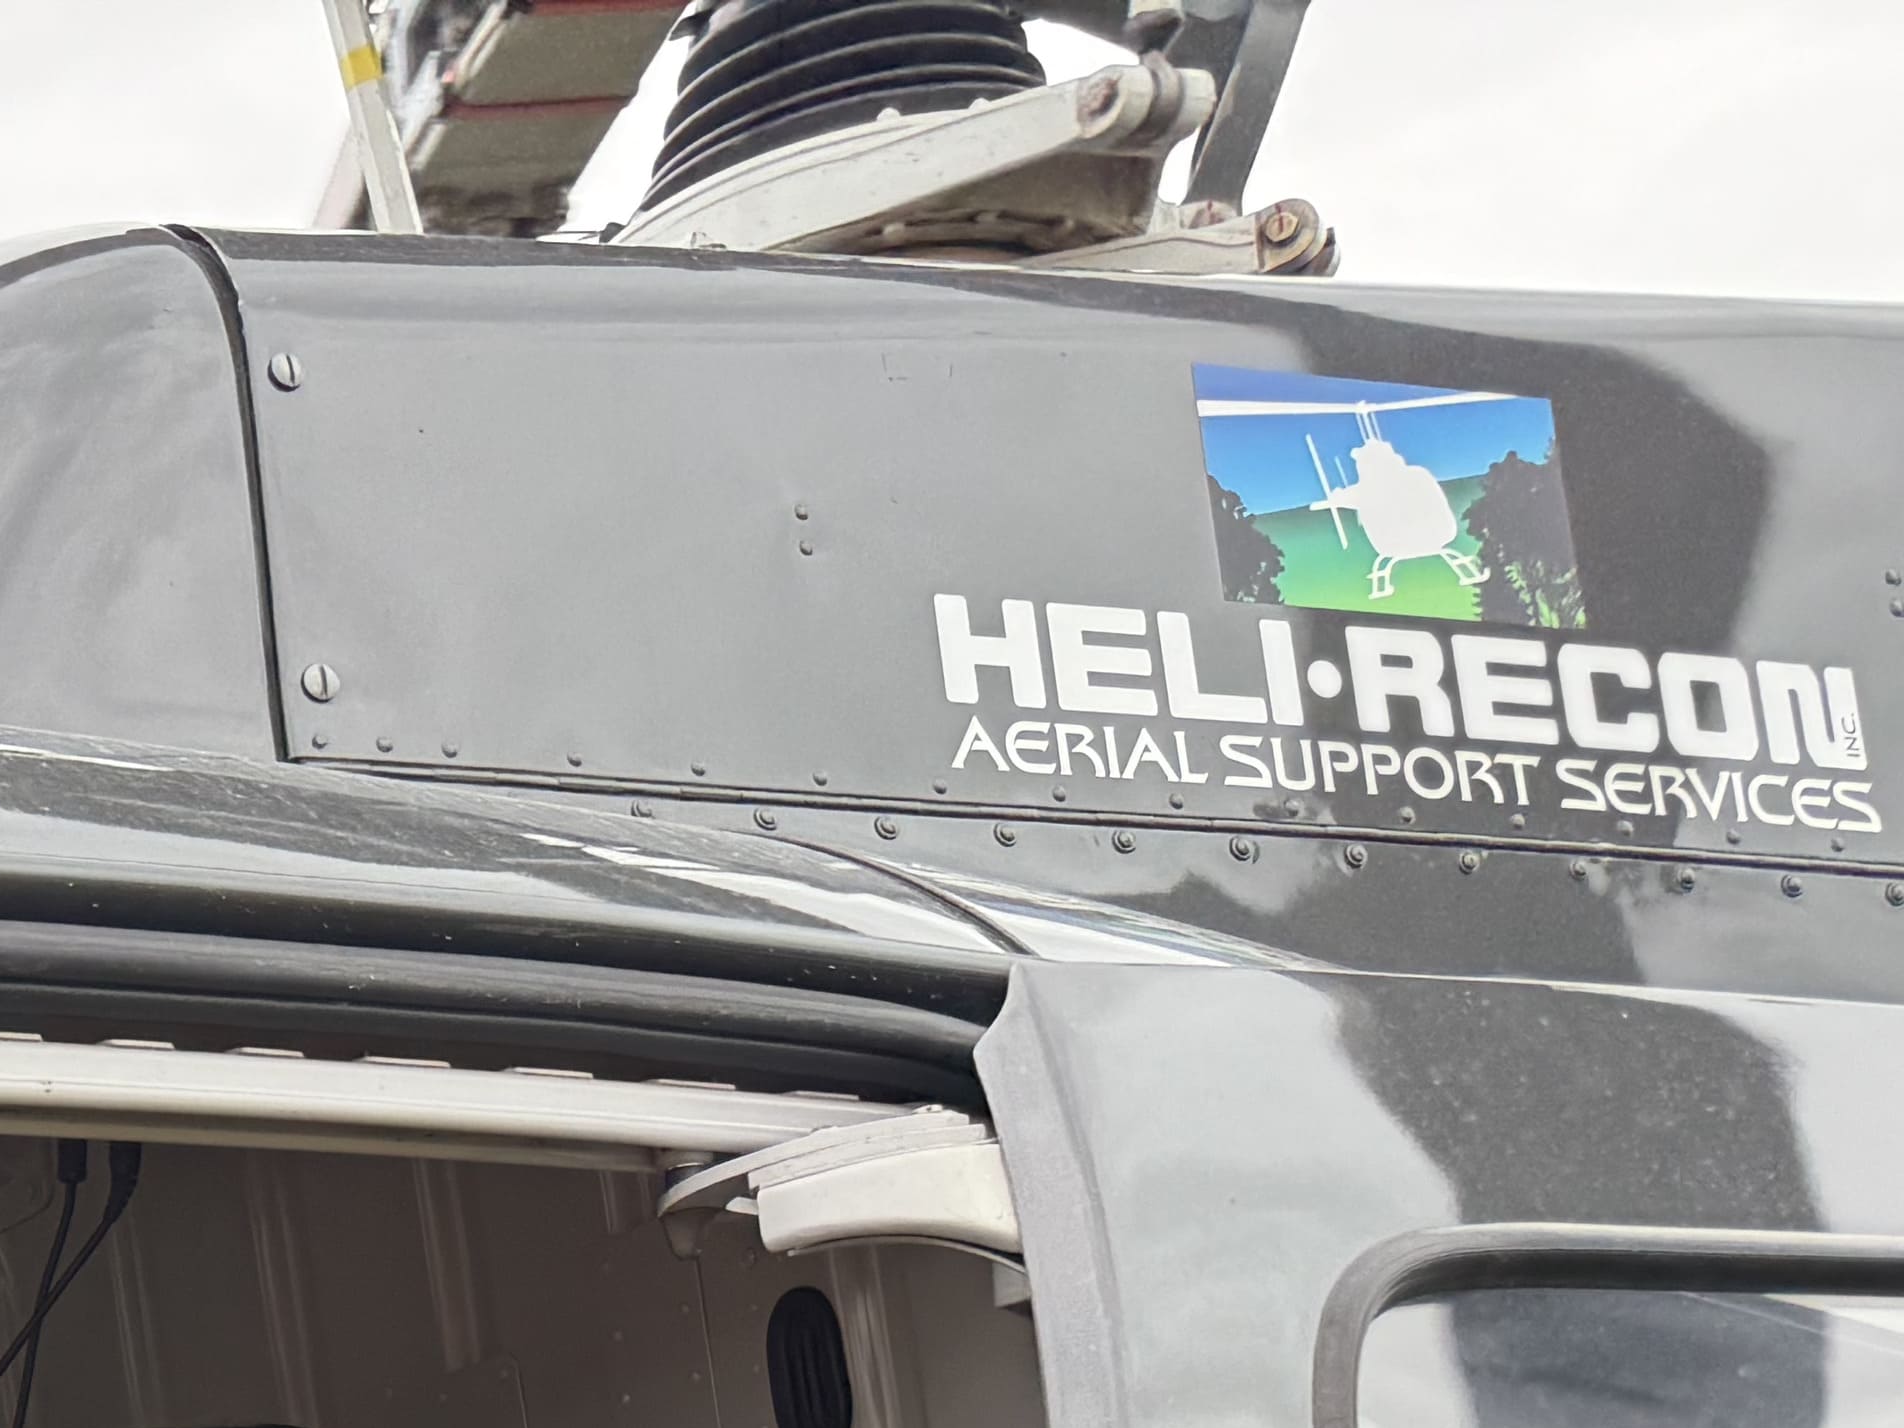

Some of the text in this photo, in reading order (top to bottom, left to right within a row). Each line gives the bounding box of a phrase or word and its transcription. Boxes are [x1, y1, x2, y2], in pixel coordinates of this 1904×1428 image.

[1840, 712, 1861, 758] INC.
[952, 720, 1884, 833] AERIAL SUPPORT SERVICES
